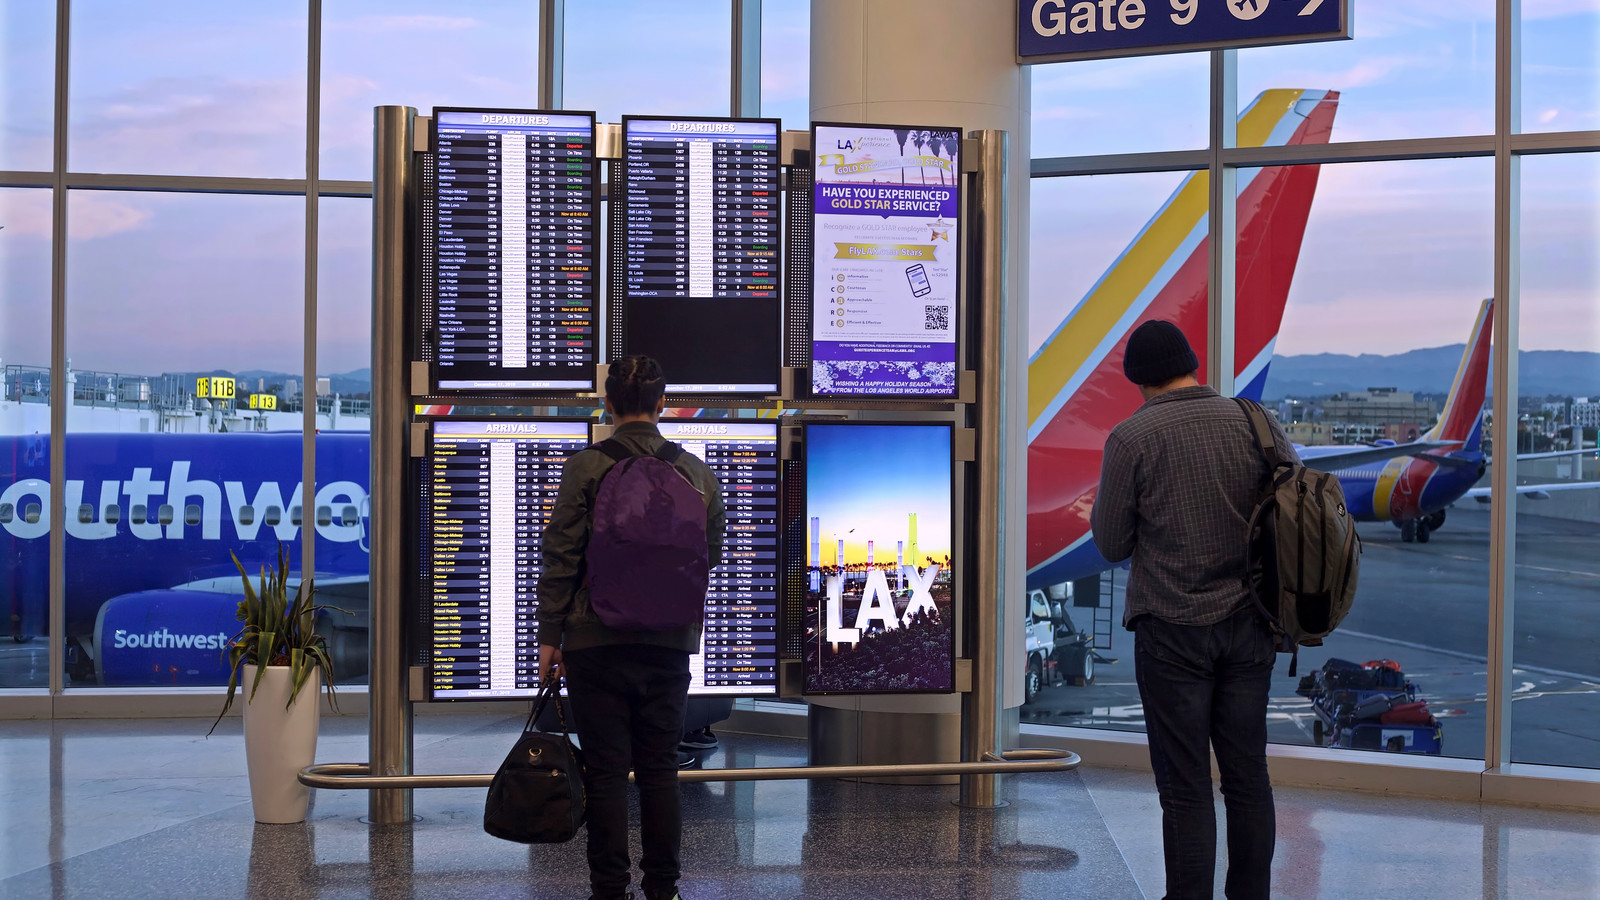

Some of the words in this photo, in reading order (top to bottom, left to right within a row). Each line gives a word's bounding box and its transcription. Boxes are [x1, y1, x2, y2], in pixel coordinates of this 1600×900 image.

[1031, 0, 1145, 37] Gate
[1170, 0, 1198, 25] 9
[482, 115, 548, 125] DEPARTURES
[670, 123, 735, 132] DEPARTURES
[838, 137, 863, 153] LAX
[837, 165, 858, 174] GOLD
[925, 159, 944, 167] STAR
[823, 187, 851, 197] HAVE
[854, 188, 876, 198] YOU
[879, 189, 950, 200] EXPERIENCED
[832, 199, 862, 208] GOLD
[864, 200, 890, 209] STAR
[893, 200, 940, 211] SERVICE?
[824, 223, 855, 231] Recognize
[898, 225, 928, 233] employee
[198, 380, 208, 397] 11B
[214, 380, 234, 396] 11B
[263, 397, 273, 408] 13
[486, 424, 537, 433] ARRIVALS
[677, 425, 728, 434] ARRIVALS
[826, 564, 940, 643] LAX
[114, 629, 228, 650] Southwest
